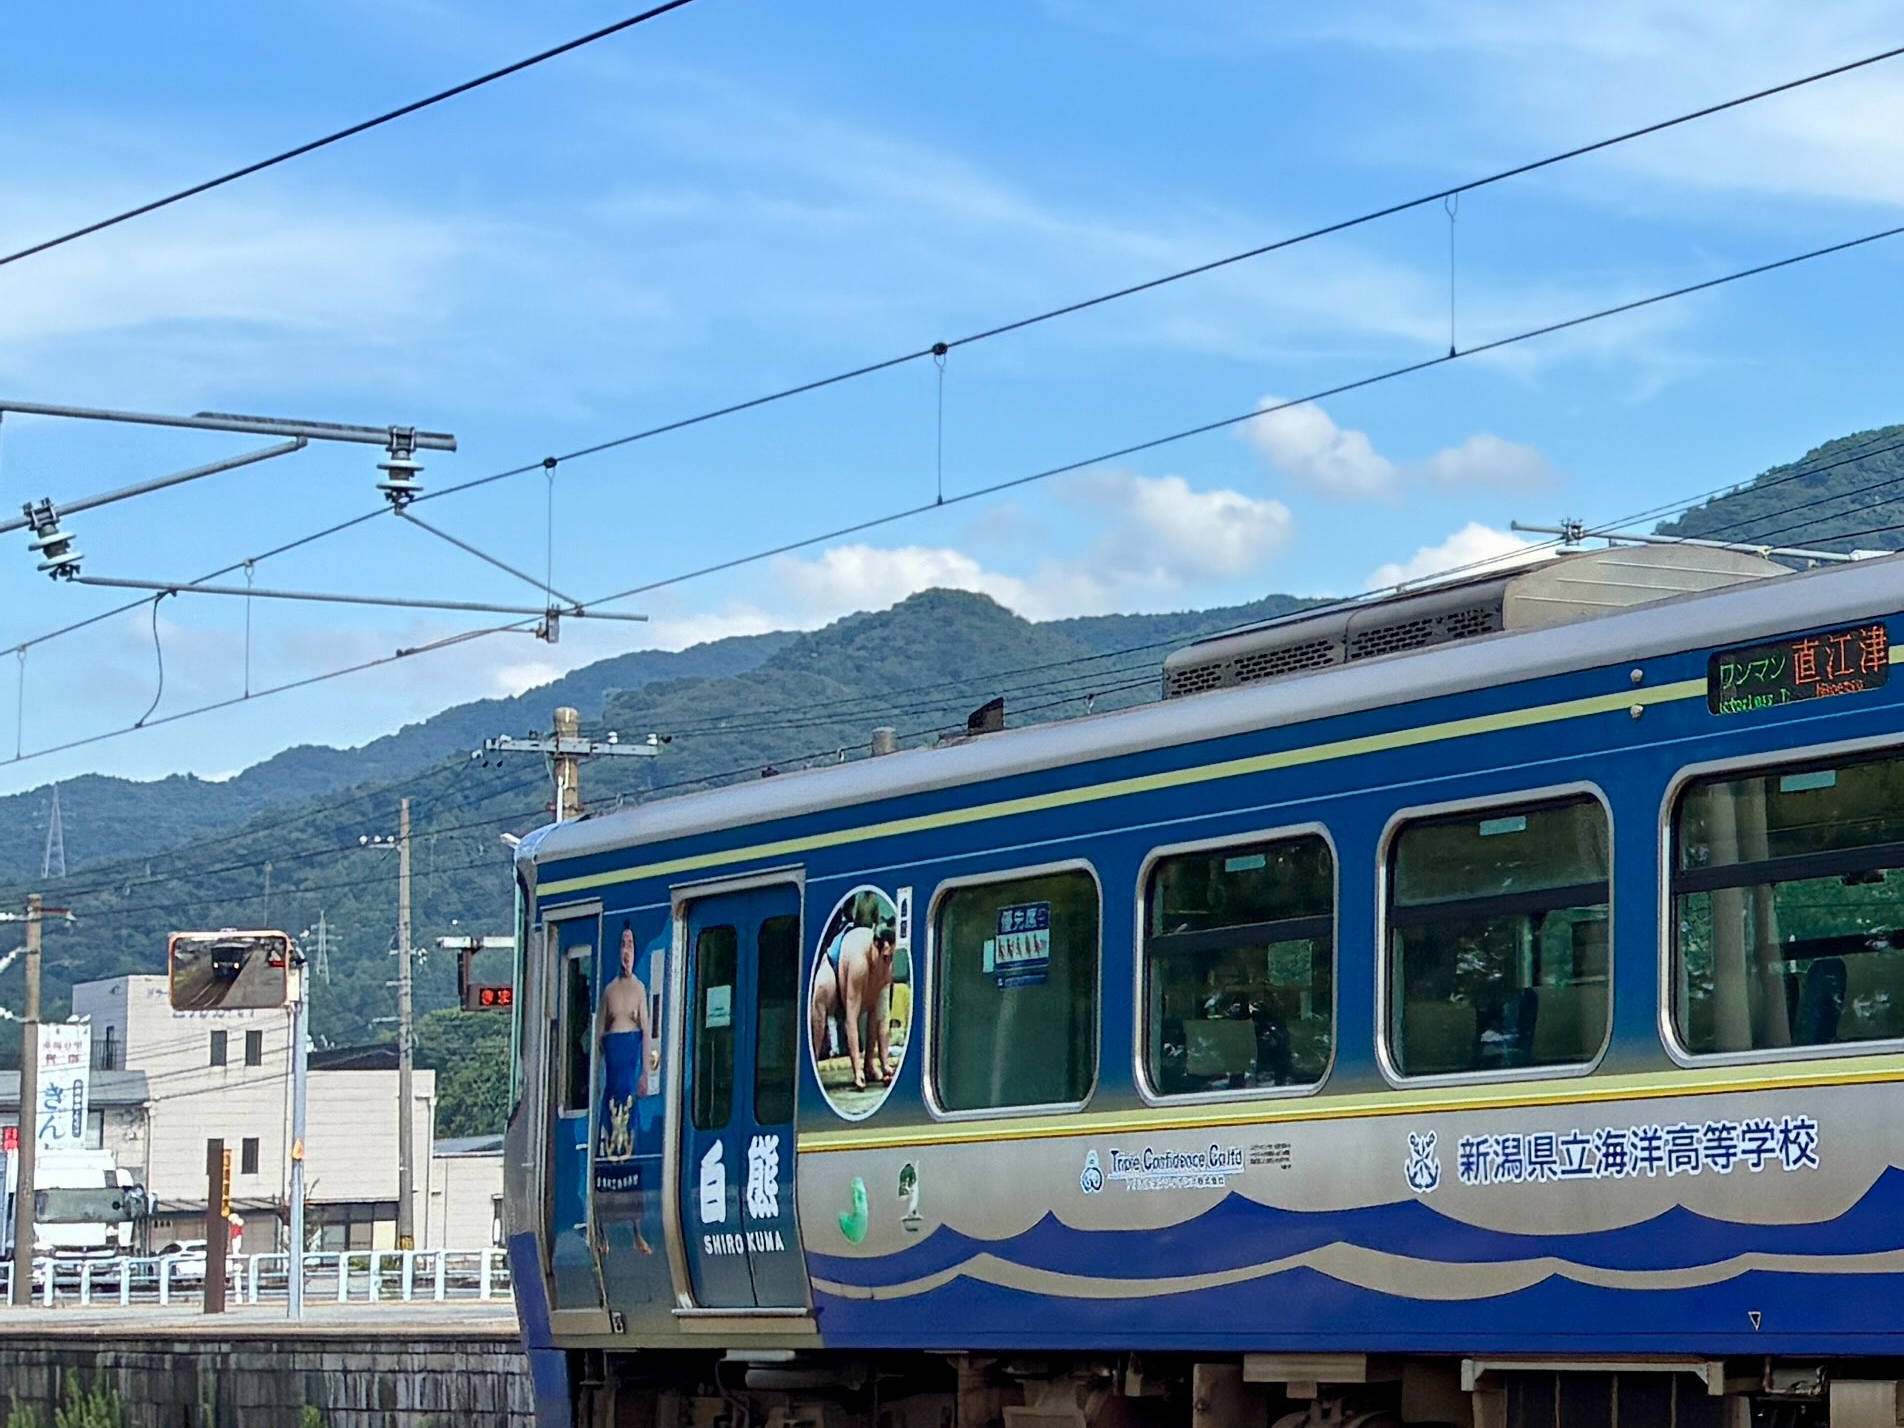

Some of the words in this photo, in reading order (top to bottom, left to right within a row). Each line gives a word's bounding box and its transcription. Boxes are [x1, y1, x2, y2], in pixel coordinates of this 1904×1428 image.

[1792, 626, 1888, 685] 直江津
[700, 1134, 780, 1223] 白熊
[1459, 1117, 1817, 1183] 新潟県立海洋高等学校
